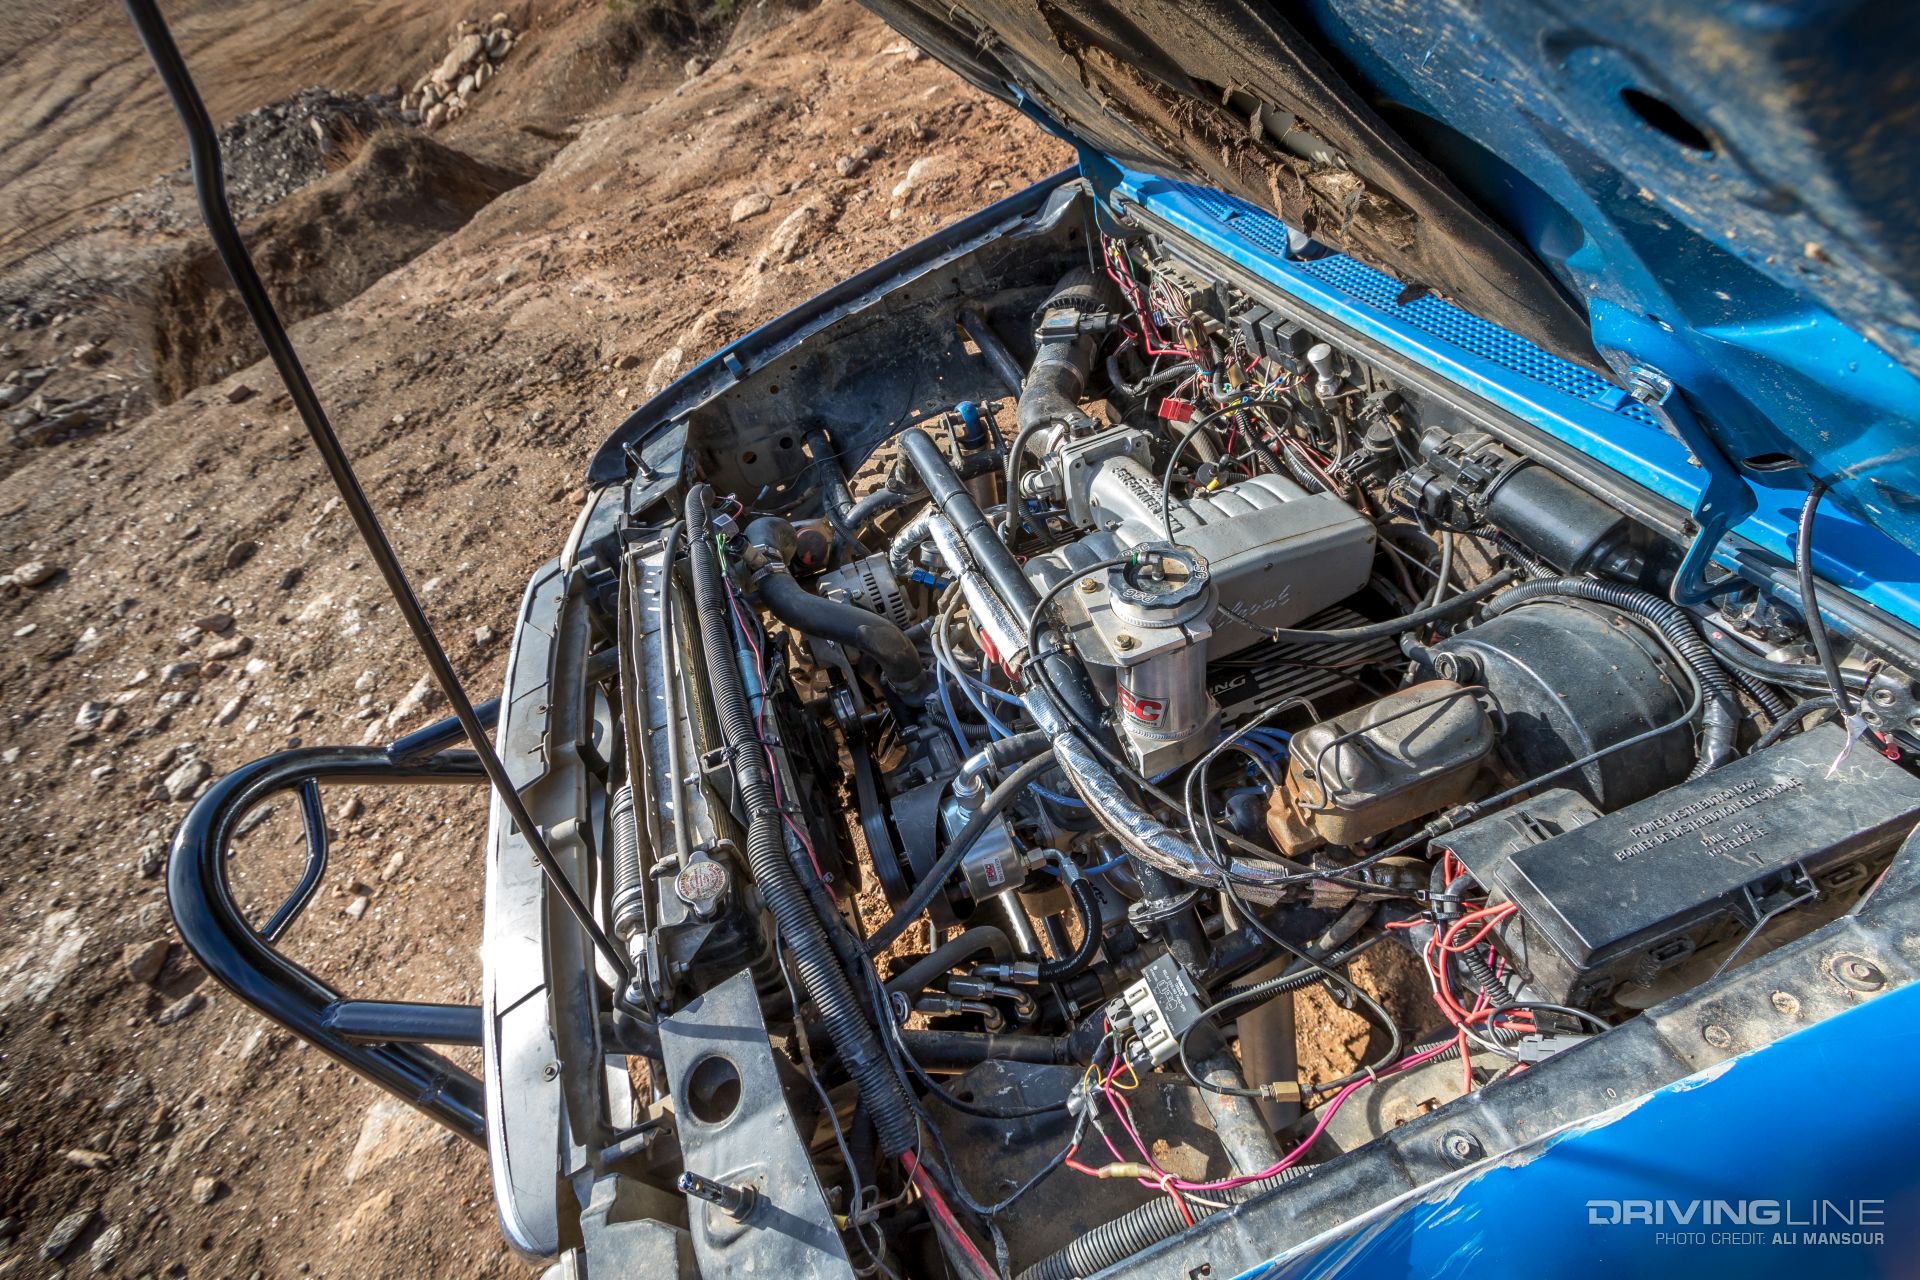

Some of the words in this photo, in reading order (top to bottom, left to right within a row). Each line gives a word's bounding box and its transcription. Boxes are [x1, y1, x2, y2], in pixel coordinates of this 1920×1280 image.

[1122, 588, 1158, 604] PSC
[1118, 685, 1163, 721] SC
[1630, 816, 1674, 838] POWER
[1668, 791, 1737, 823] DISTRIBUTION
[1733, 779, 1762, 795] BOX
[1670, 803, 1741, 839] DISTRIBUTION
[1700, 833, 1729, 848] PULL
[1729, 821, 1754, 835] TAB
[1722, 827, 1770, 853] RELEASE
